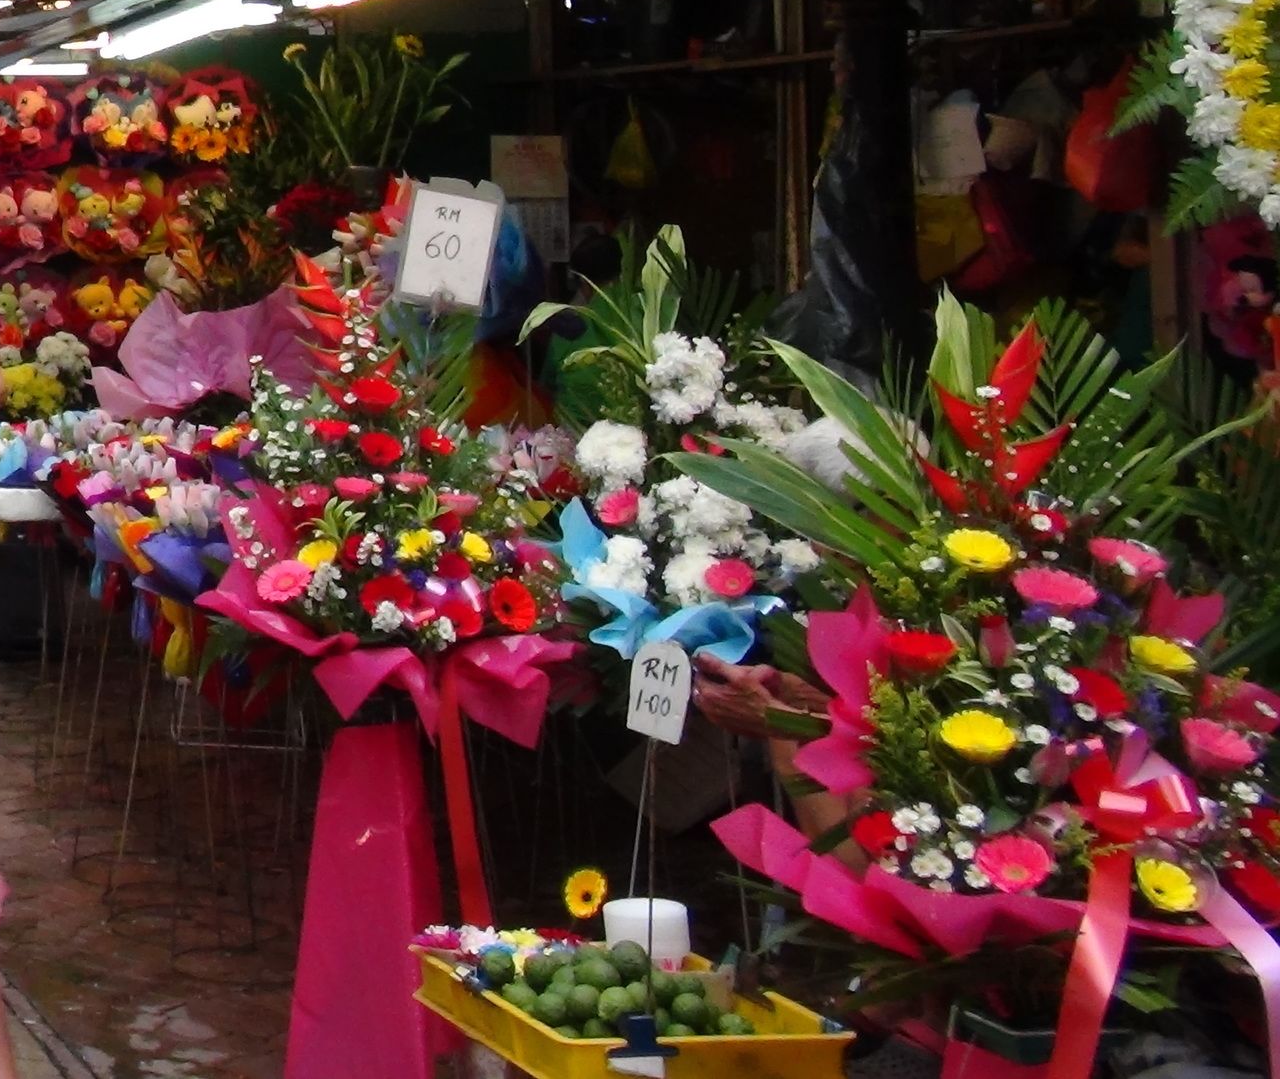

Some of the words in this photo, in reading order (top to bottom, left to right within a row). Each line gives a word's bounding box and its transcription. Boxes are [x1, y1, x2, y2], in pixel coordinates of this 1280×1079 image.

[434, 206, 462, 223] RM
[424, 231, 461, 261] 60
[641, 657, 680, 687] RM
